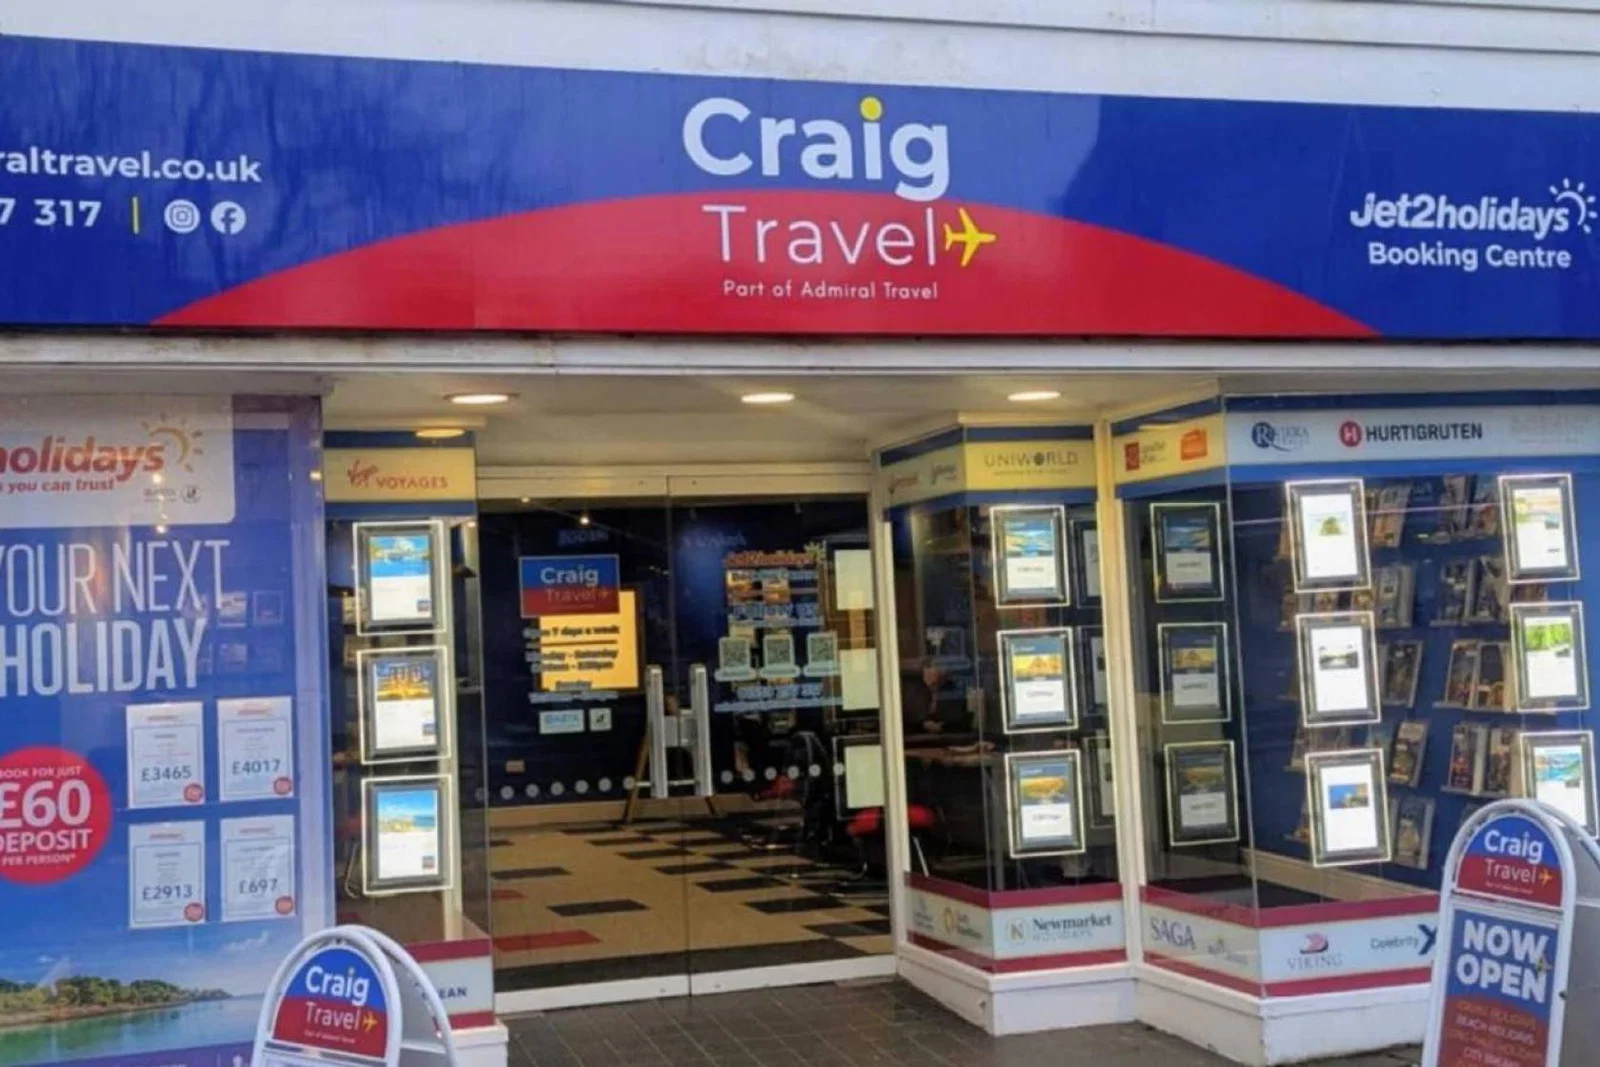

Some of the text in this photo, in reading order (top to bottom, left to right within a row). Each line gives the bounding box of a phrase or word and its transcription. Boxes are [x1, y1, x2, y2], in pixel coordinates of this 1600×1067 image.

[682, 96, 949, 201] Craig
[34, 199, 102, 227] 317
[1349, 192, 1569, 240] Jet2holidays
[702, 203, 936, 266] Travel
[1368, 241, 1572, 272] Booking Centre
[723, 280, 938, 299] Part of Admiral Travel
[1366, 422, 1483, 442] HURTIGRUTEN
[8, 478, 114, 494] you can trust
[376, 475, 448, 490] VOYAGES
[0, 540, 230, 617] OUR NEXT
[540, 564, 599, 587] Craig
[0, 618, 207, 697] HOLIDAY
[57, 765, 82, 778] JUST
[141, 764, 192, 782] £3465
[232, 758, 281, 775] £4017
[0, 779, 91, 828] £60
[1484, 828, 1544, 865] Craig
[2, 854, 24, 867] PER
[1484, 857, 1537, 885] Travel
[142, 884, 193, 901] £2913
[238, 877, 278, 895] £697
[1032, 912, 1112, 932] Newmarket
[1149, 916, 1197, 951] SAGA
[1370, 935, 1419, 951] Celebrity
[1463, 919, 1549, 964] NOW
[1287, 953, 1344, 971] VIKING
[306, 965, 369, 1007] Craig
[1455, 953, 1546, 1004] OPEN
[438, 986, 468, 999] EAN
[306, 1001, 361, 1031] Travel
